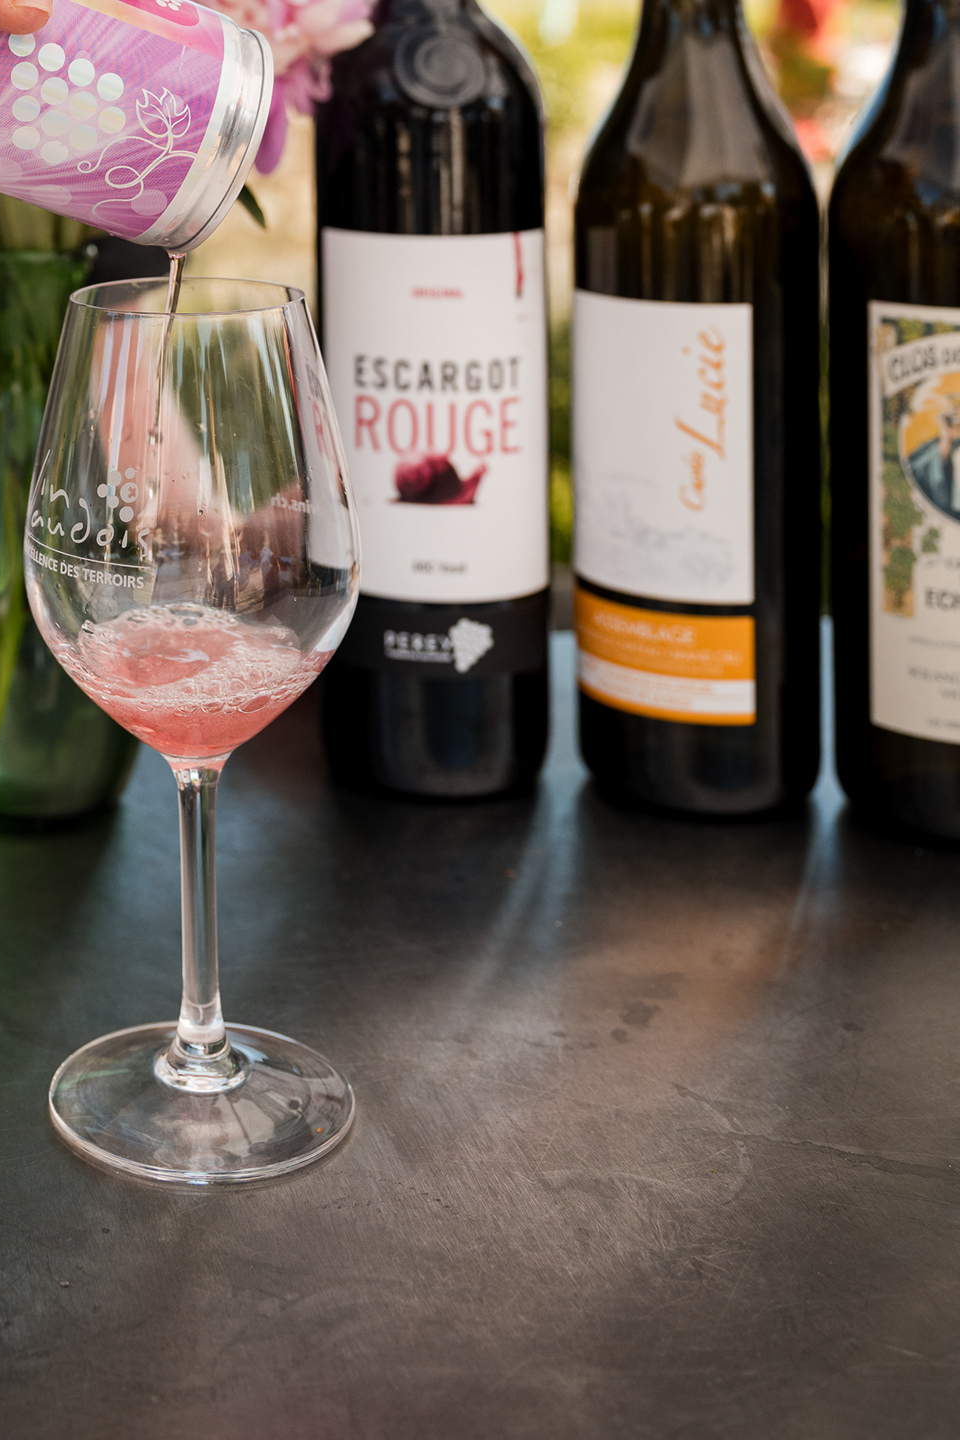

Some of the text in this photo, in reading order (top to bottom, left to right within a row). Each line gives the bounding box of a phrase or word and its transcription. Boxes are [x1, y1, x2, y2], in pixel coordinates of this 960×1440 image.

[354, 354, 520, 393] ESCARGOT
[673, 322, 728, 463] Lucie
[354, 394, 522, 457] ROUGE
[59, 563, 80, 580] DES
[82, 568, 145, 590] TERROIRS
